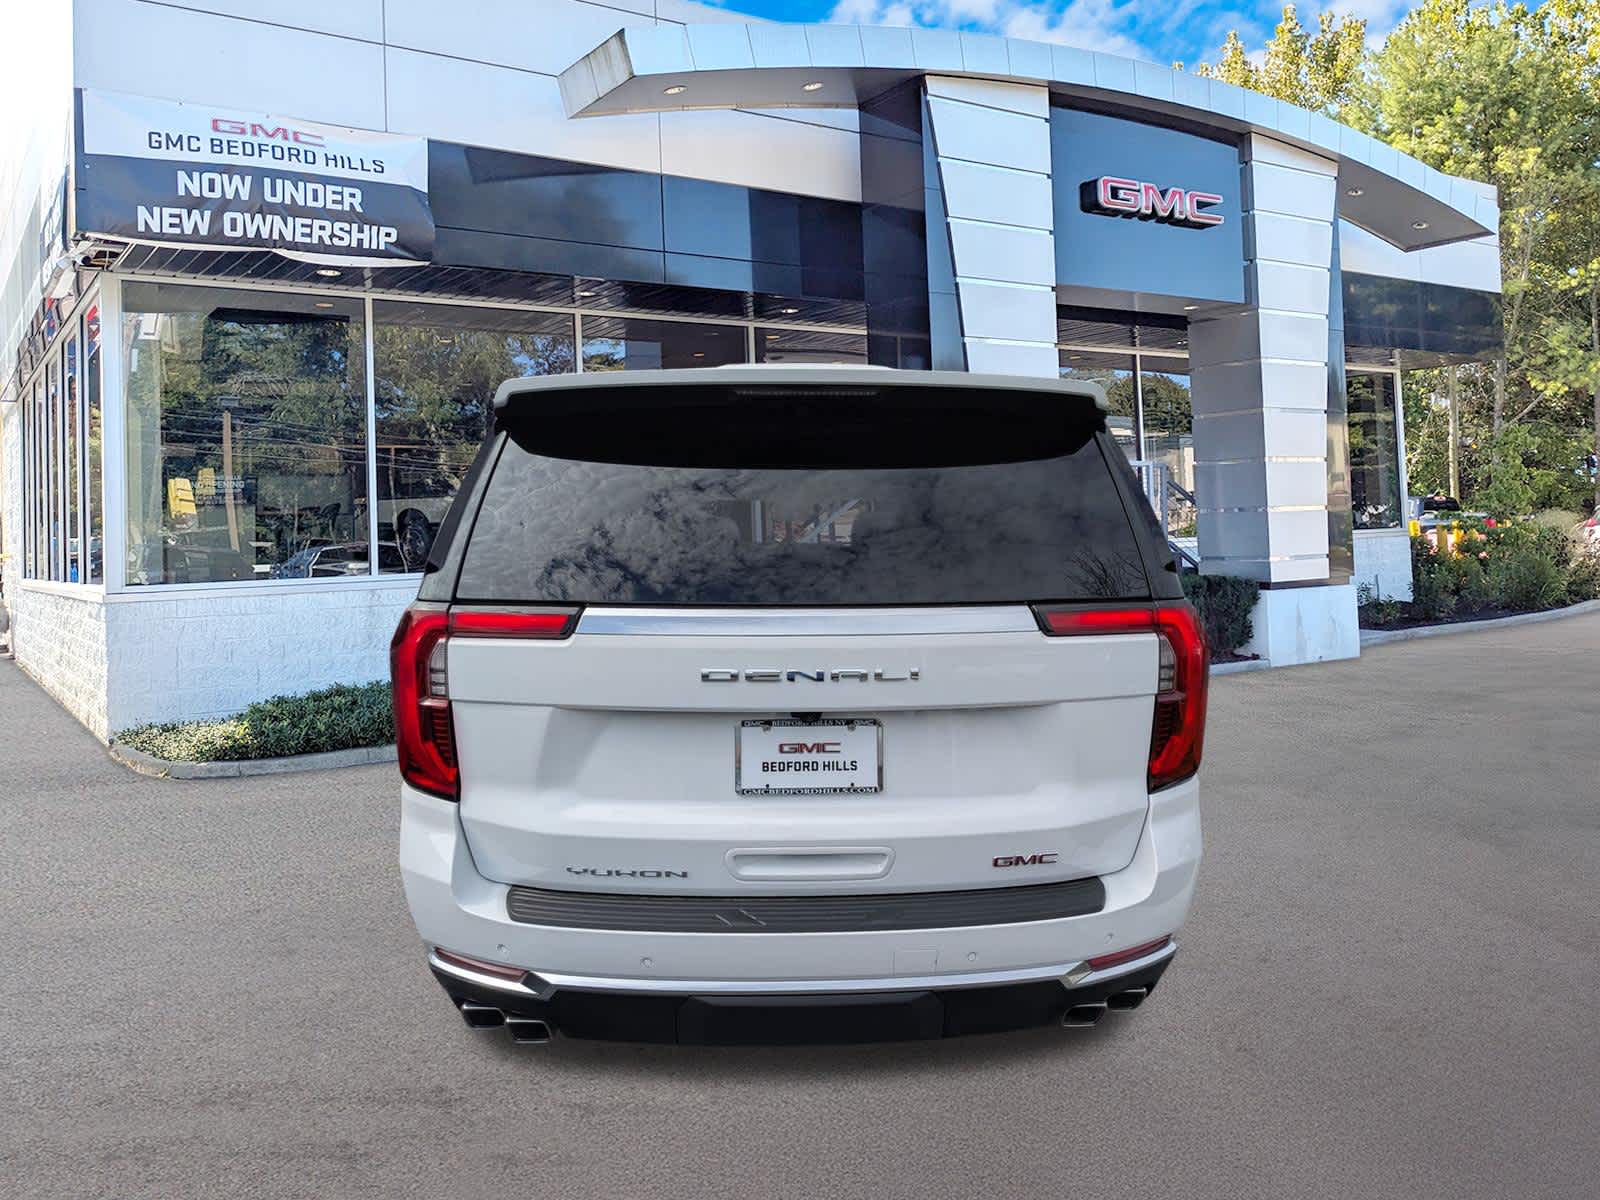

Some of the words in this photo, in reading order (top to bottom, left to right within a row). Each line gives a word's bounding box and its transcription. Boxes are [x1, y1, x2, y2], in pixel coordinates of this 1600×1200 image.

[211, 118, 325, 147] GMC
[148, 130, 202, 152] GMC
[210, 138, 317, 165] BEDFORD
[324, 153, 385, 174] HILLS
[176, 169, 253, 202] NOW
[263, 177, 364, 213] UNDER
[1098, 176, 1225, 224] GMC
[136, 205, 213, 236] NEW
[223, 211, 398, 250] OWNERSHIP
[700, 667, 921, 683] DENALI
[779, 742, 841, 754] GMC
[762, 761, 819, 772] BEDFORD
[822, 760, 858, 772] HILLS
[992, 853, 1058, 868] GMC
[566, 866, 688, 878] YUKON
